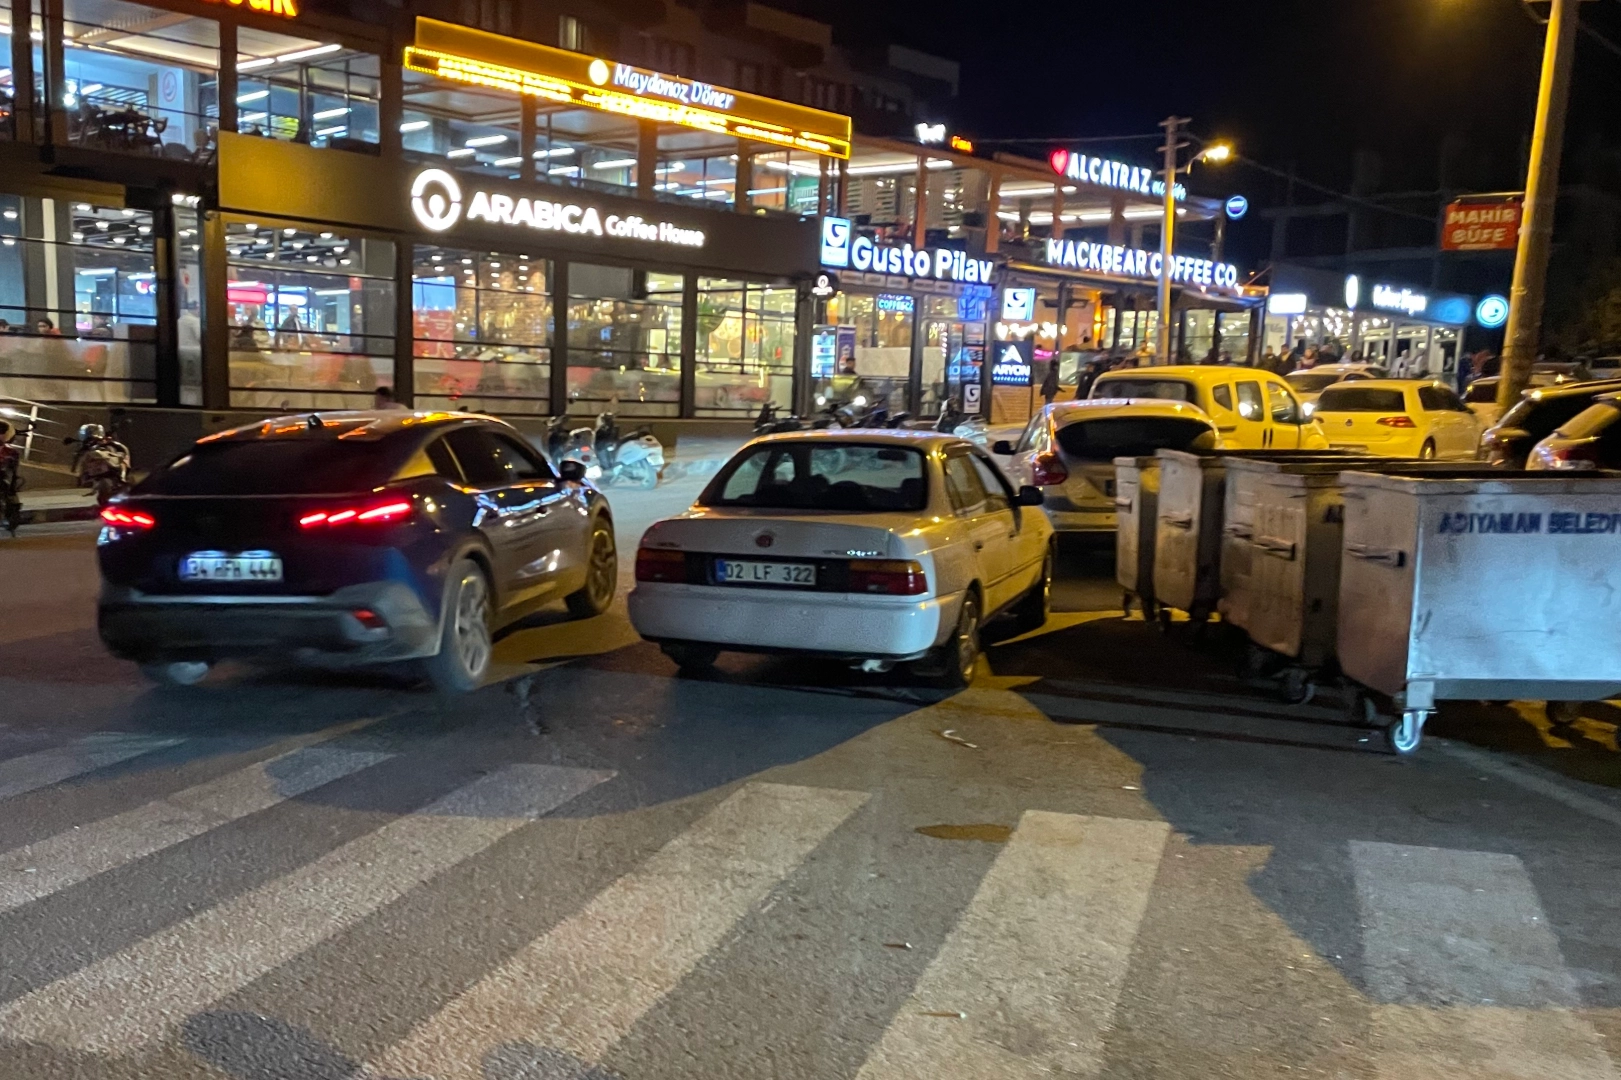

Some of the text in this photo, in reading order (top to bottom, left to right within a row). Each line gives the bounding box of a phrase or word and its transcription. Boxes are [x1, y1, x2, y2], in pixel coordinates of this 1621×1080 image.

[614, 62, 689, 104] Maydonoz
[690, 80, 734, 109] Döner
[1068, 153, 1151, 192] ALCATRAZ
[467, 191, 705, 246] ARABICA Coffee House
[1452, 225, 1507, 243] BÜFE
[852, 237, 930, 277] Gusto
[936, 249, 993, 283] Pilav
[1048, 238, 1147, 275] MACKBEAR
[1151, 253, 1213, 283] COFFEE
[726, 563, 812, 582] 02 LF 322
